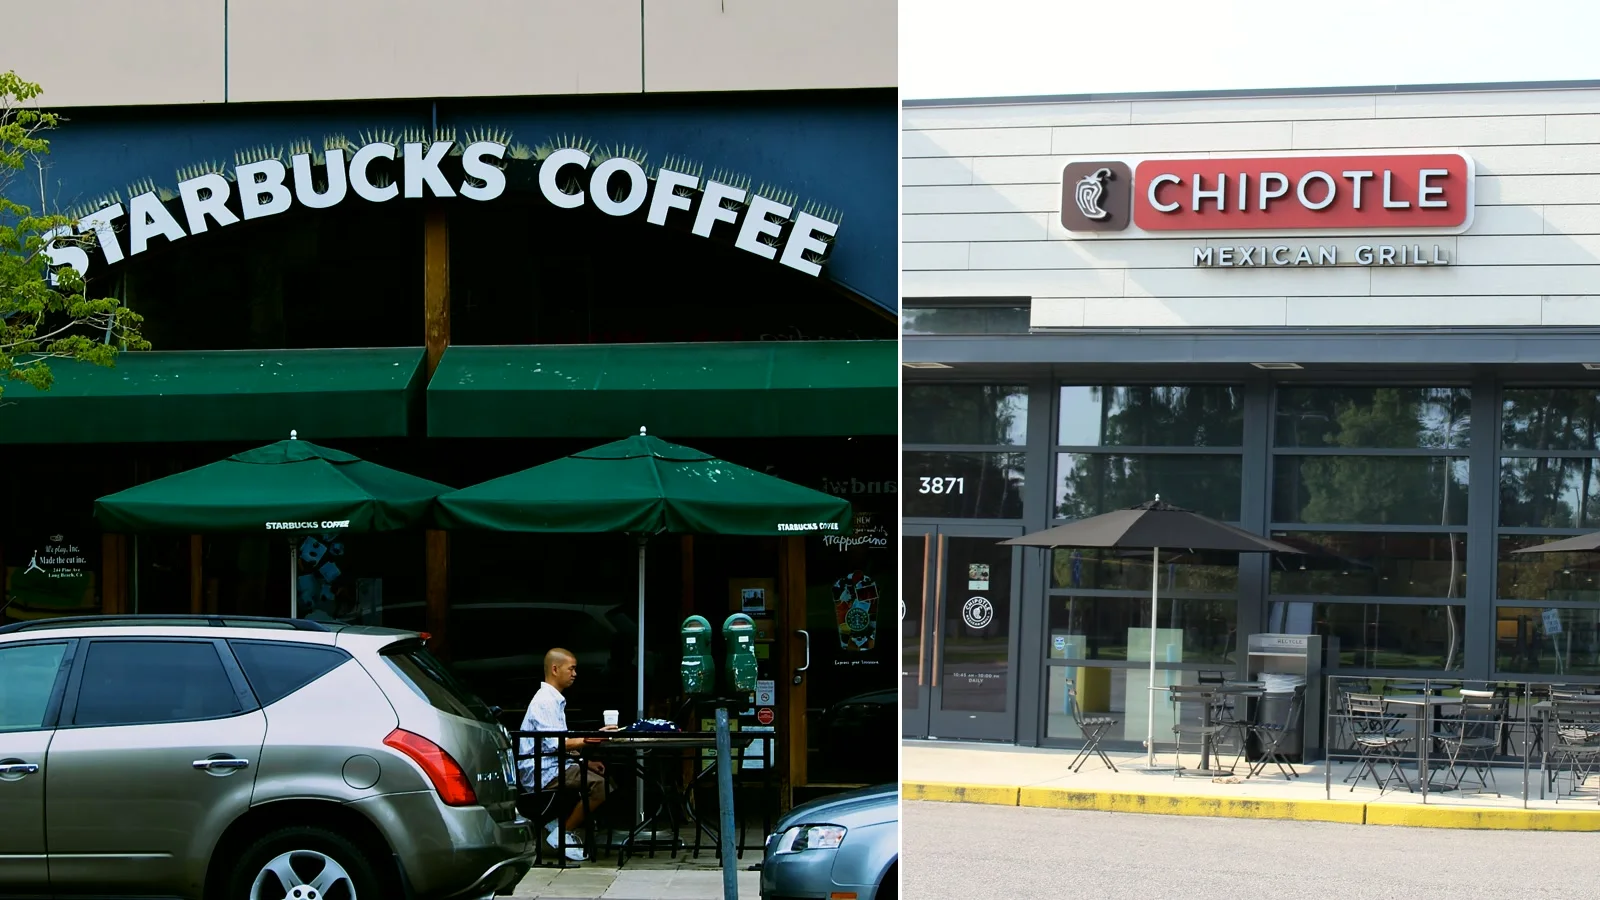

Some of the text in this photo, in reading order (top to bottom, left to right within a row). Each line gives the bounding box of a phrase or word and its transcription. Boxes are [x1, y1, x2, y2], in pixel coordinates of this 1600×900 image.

[1147, 168, 1449, 213] CHIPOTLE
[39, 140, 839, 287] STARBUCKS COFFEE
[1193, 244, 1449, 266] MEXICAN GRILL
[918, 476, 964, 495] 3871
[265, 521, 319, 530] STARBUCKS
[777, 522, 818, 531] STARBUCKS
[856, 516, 871, 524] NEW
[40, 556, 56, 564] Made
[56, 556, 65, 564] the
[965, 598, 991, 611] CHIPOTLE
